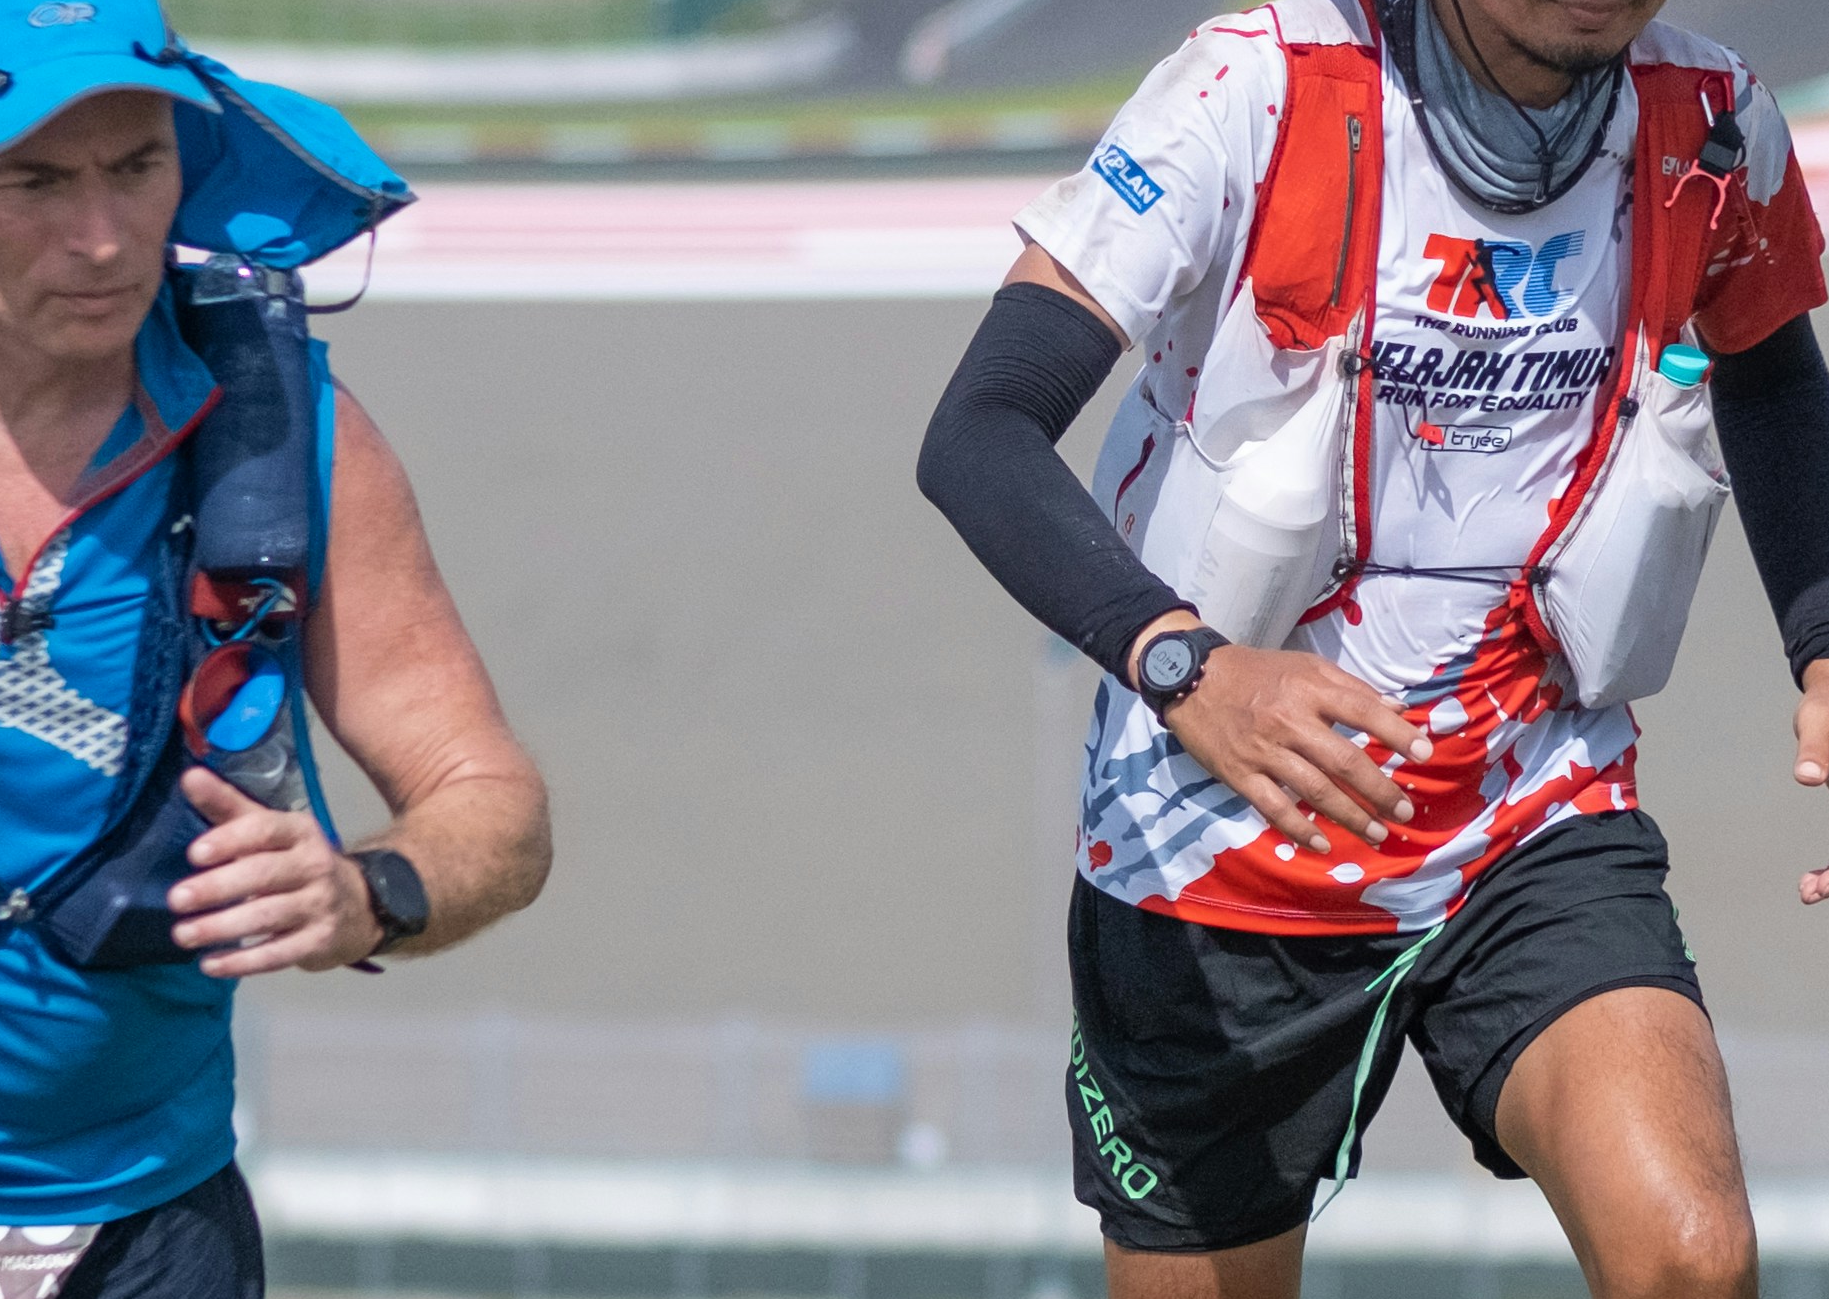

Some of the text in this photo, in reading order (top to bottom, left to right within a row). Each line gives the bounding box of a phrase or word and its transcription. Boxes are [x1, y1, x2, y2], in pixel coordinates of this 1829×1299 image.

[1423, 230, 1586, 320] TRC
[1415, 315, 1579, 340] THE RUNNING CLUB
[1511, 346, 1616, 392] TIMUR
[1376, 385, 1590, 412] RUN FOR EQUALITY
